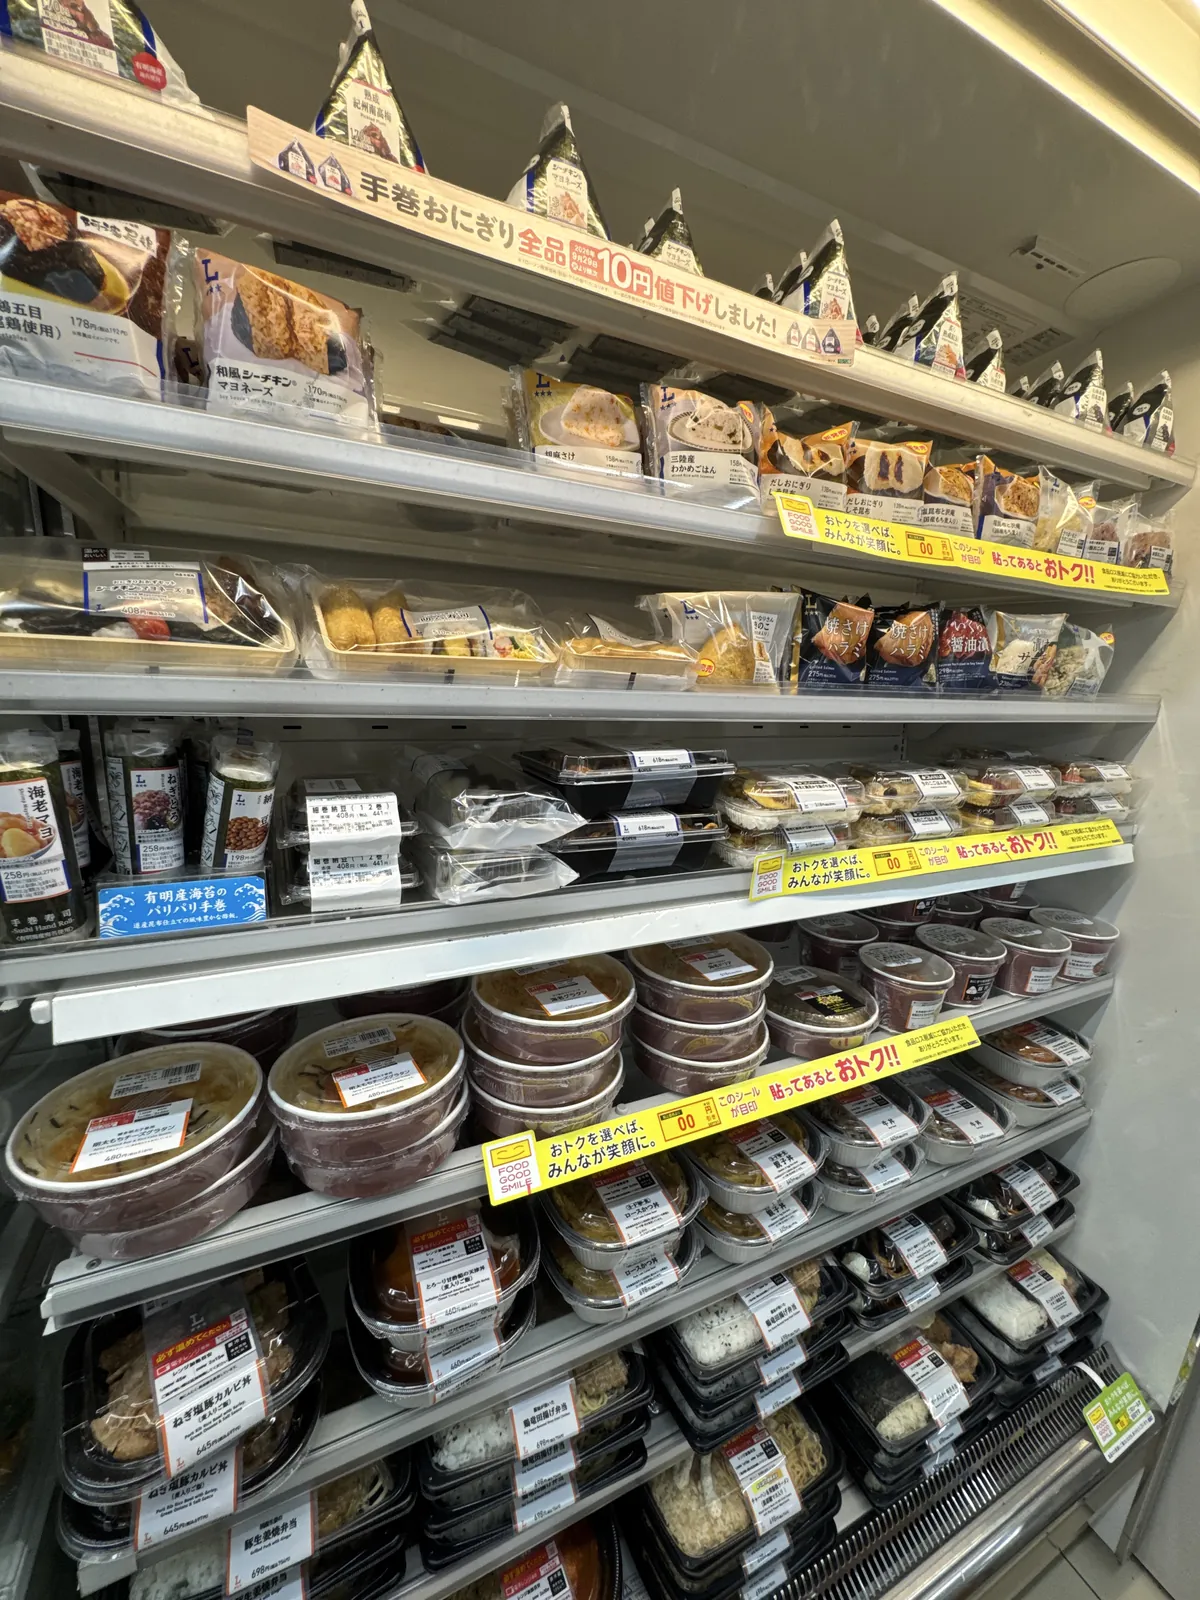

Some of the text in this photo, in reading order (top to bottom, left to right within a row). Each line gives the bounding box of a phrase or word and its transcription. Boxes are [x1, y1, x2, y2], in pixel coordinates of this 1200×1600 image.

[364, 89, 380, 104] 熟成
[353, 97, 391, 122] 紀州南高梅
[552, 173, 582, 190] マヨネーズ
[360, 172, 566, 266] 手巻おにぎり全品
[572, 252, 597, 269] 9月29日
[0, 314, 61, 340] 鶏使用)
[218, 380, 273, 397] マヨネーズ
[536, 373, 550, 389] L
[661, 386, 675, 402] L
[671, 454, 695, 464] 三陸産
[671, 464, 717, 475] わかめごはん
[770, 479, 811, 491] だしおにぎり
[845, 506, 871, 515] しそ昆布
[847, 498, 883, 508] だしおにぎり
[788, 512, 810, 522] FOOD
[790, 519, 812, 528] GOOD
[791, 526, 814, 535] SMILE
[824, 515, 894, 539] おトクを選べば、
[824, 527, 901, 556] みんなが笑顔に。
[953, 543, 985, 555] このシール
[961, 554, 981, 565] が目印
[684, 601, 696, 614] L
[806, 594, 817, 609] L
[754, 621, 770, 631] きのこ
[825, 616, 869, 637] 焼さけ
[891, 622, 928, 640] 焼さけ
[827, 642, 862, 659] ハラミ
[891, 644, 925, 660] ハラミ
[136, 775, 146, 784] L
[167, 773, 179, 824] ねぎとろ
[236, 794, 245, 803] L
[27, 786, 53, 839] 海老マヨ
[918, 845, 950, 857] このシール
[792, 853, 863, 873] おトクを選べば、
[928, 856, 949, 866] が目印
[757, 878, 777, 888] GOOD
[758, 872, 778, 881] FOOD
[788, 868, 870, 889] みんなが笑顔に。
[144, 886, 227, 904] 有明産海苔の
[757, 885, 777, 895] SMILE
[147, 901, 227, 917] パリパリ手巻
[35, 921, 57, 931] Hand
[918, 1035, 963, 1052] ありがとうございます。
[718, 1087, 760, 1107] このシール
[731, 1101, 758, 1118] が目印
[882, 1118, 895, 1127] 牛丼
[550, 1120, 645, 1157] おトクを選べば、
[548, 1137, 657, 1178] みんなが笑顔に。
[773, 1154, 794, 1169] 親子丼
[498, 1160, 530, 1175] FOOD
[499, 1169, 532, 1184] GOOD
[501, 1178, 533, 1194] SMILE
[624, 1201, 660, 1218] ロースかつ丼
[625, 1257, 658, 1276] ロースかつ丼
[190, 1314, 204, 1327] L
[156, 1323, 229, 1364] 必ず温めてください
[173, 1375, 252, 1428] ねぎ塩豚カルビ丼
[523, 1402, 568, 1428] 鶏竜田揚げ弁当
[244, 1517, 298, 1551] 豚生姜焼弁当
